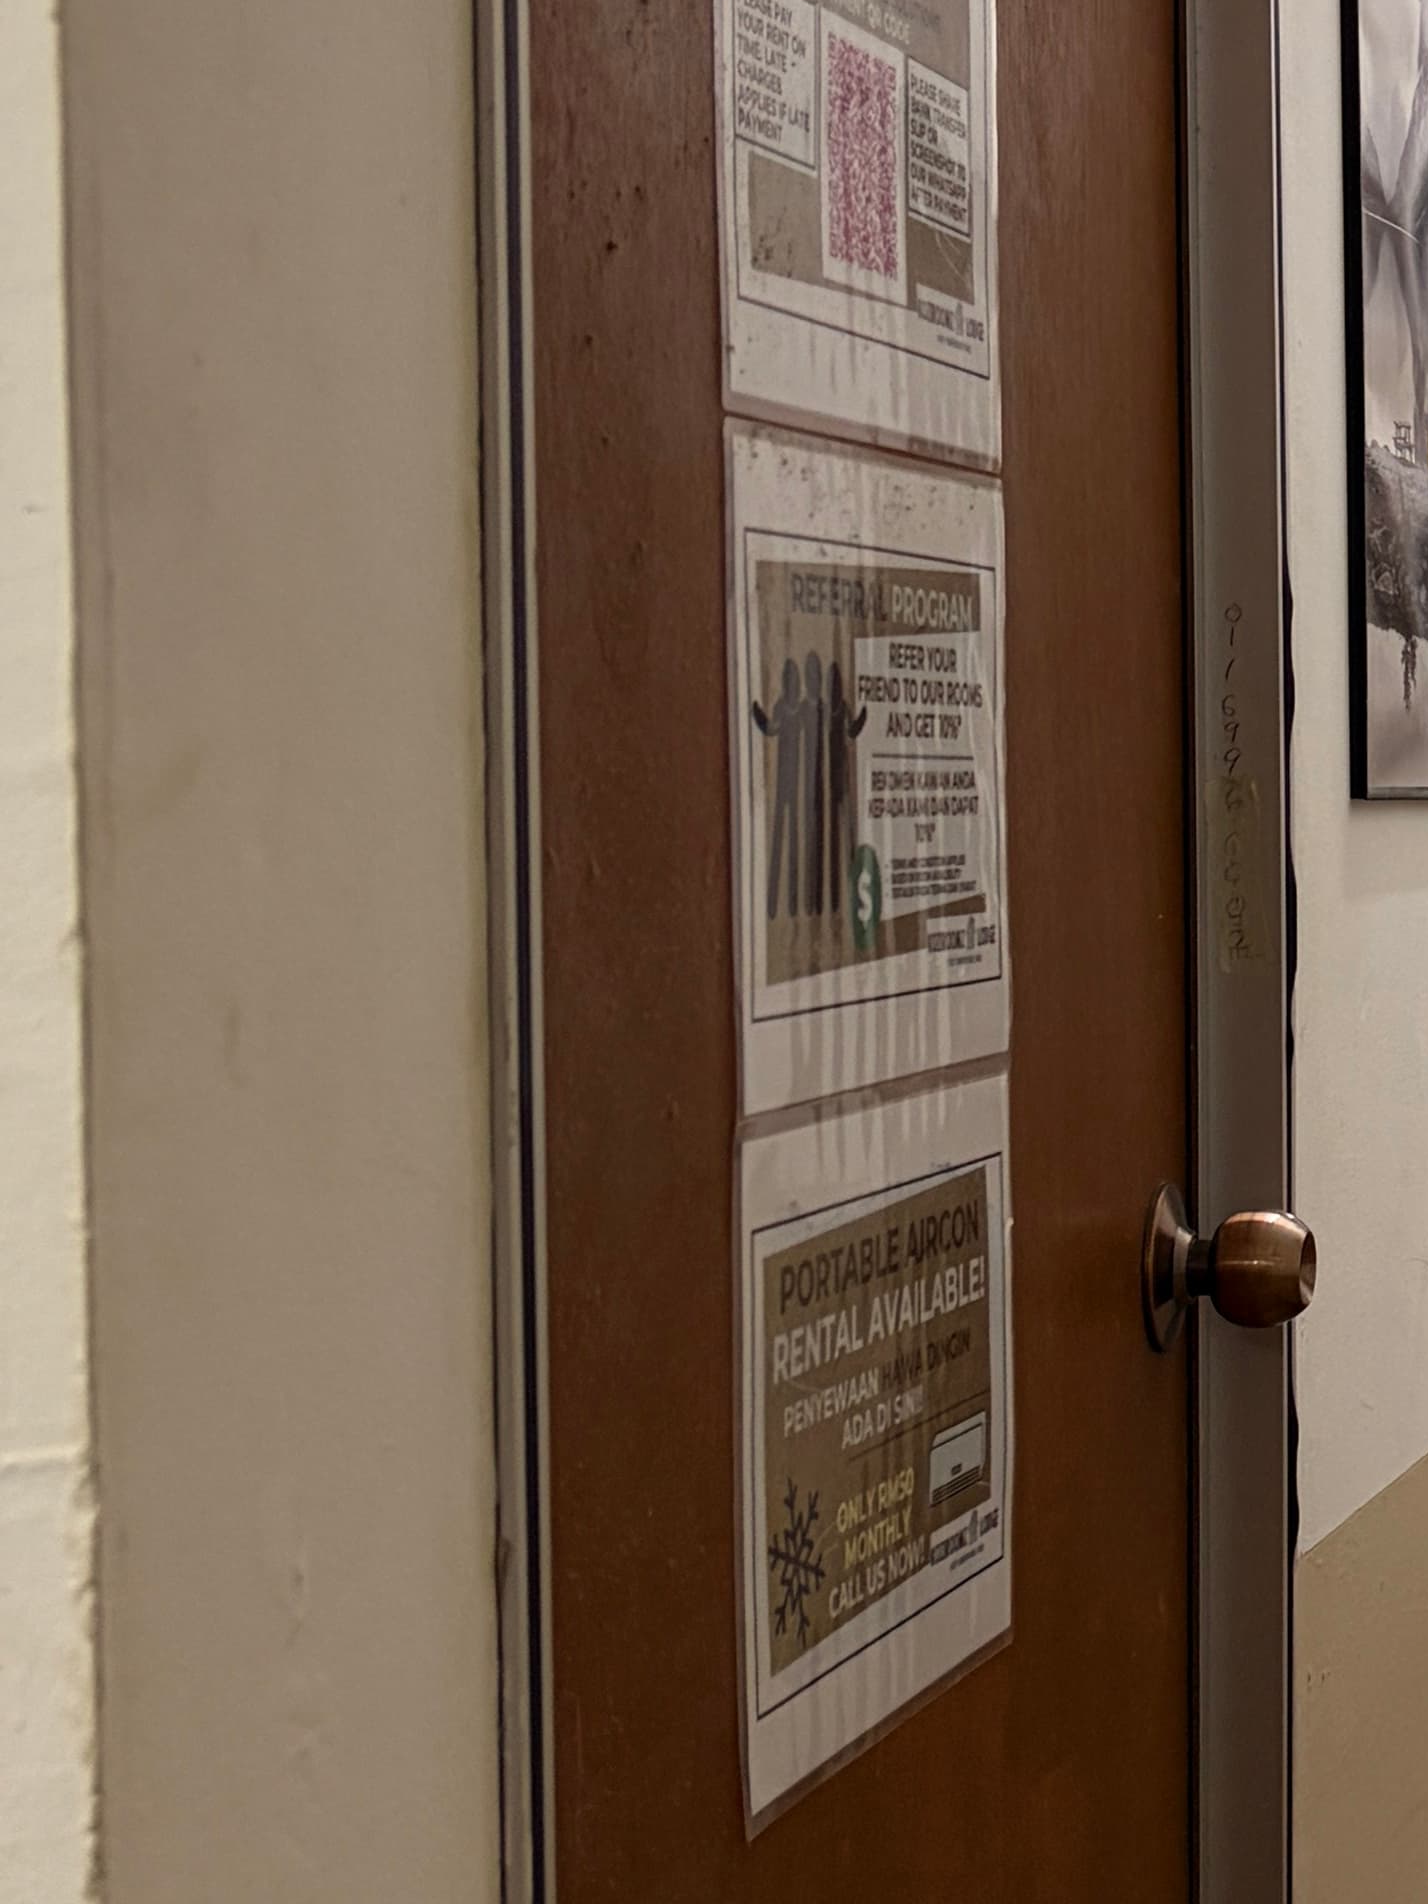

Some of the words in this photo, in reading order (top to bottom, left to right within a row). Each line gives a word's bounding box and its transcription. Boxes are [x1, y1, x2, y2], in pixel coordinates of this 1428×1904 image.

[737, 8, 764, 37] YOUR
[774, 1, 793, 28] PAY
[789, 572, 888, 622] REFERRAL
[890, 584, 973, 631] PROGRAM
[888, 642, 925, 672] REFER
[927, 647, 957, 673] YOUR
[858, 675, 900, 703] FRIEND
[902, 677, 918, 704] TO
[920, 679, 945, 706] OUR
[946, 681, 984, 708] ROOMS
[886, 711, 913, 739] AND
[915, 713, 936, 739] GET
[779, 1225, 900, 1316] PORTABLE
[903, 1199, 980, 1269] AIRCON
[773, 1304, 865, 1385] RENTAL
[867, 1255, 986, 1345] AVAILABLE!
[783, 1367, 880, 1438] PENYEWAAN
[841, 1408, 874, 1450] ADA
[876, 1401, 892, 1434] DI
[835, 1487, 878, 1534] ONLY
[844, 1505, 913, 1570] MONTHLY
[828, 1573, 865, 1619] CALL
[865, 1558, 886, 1595] US
[887, 1534, 926, 1582] NOW!
